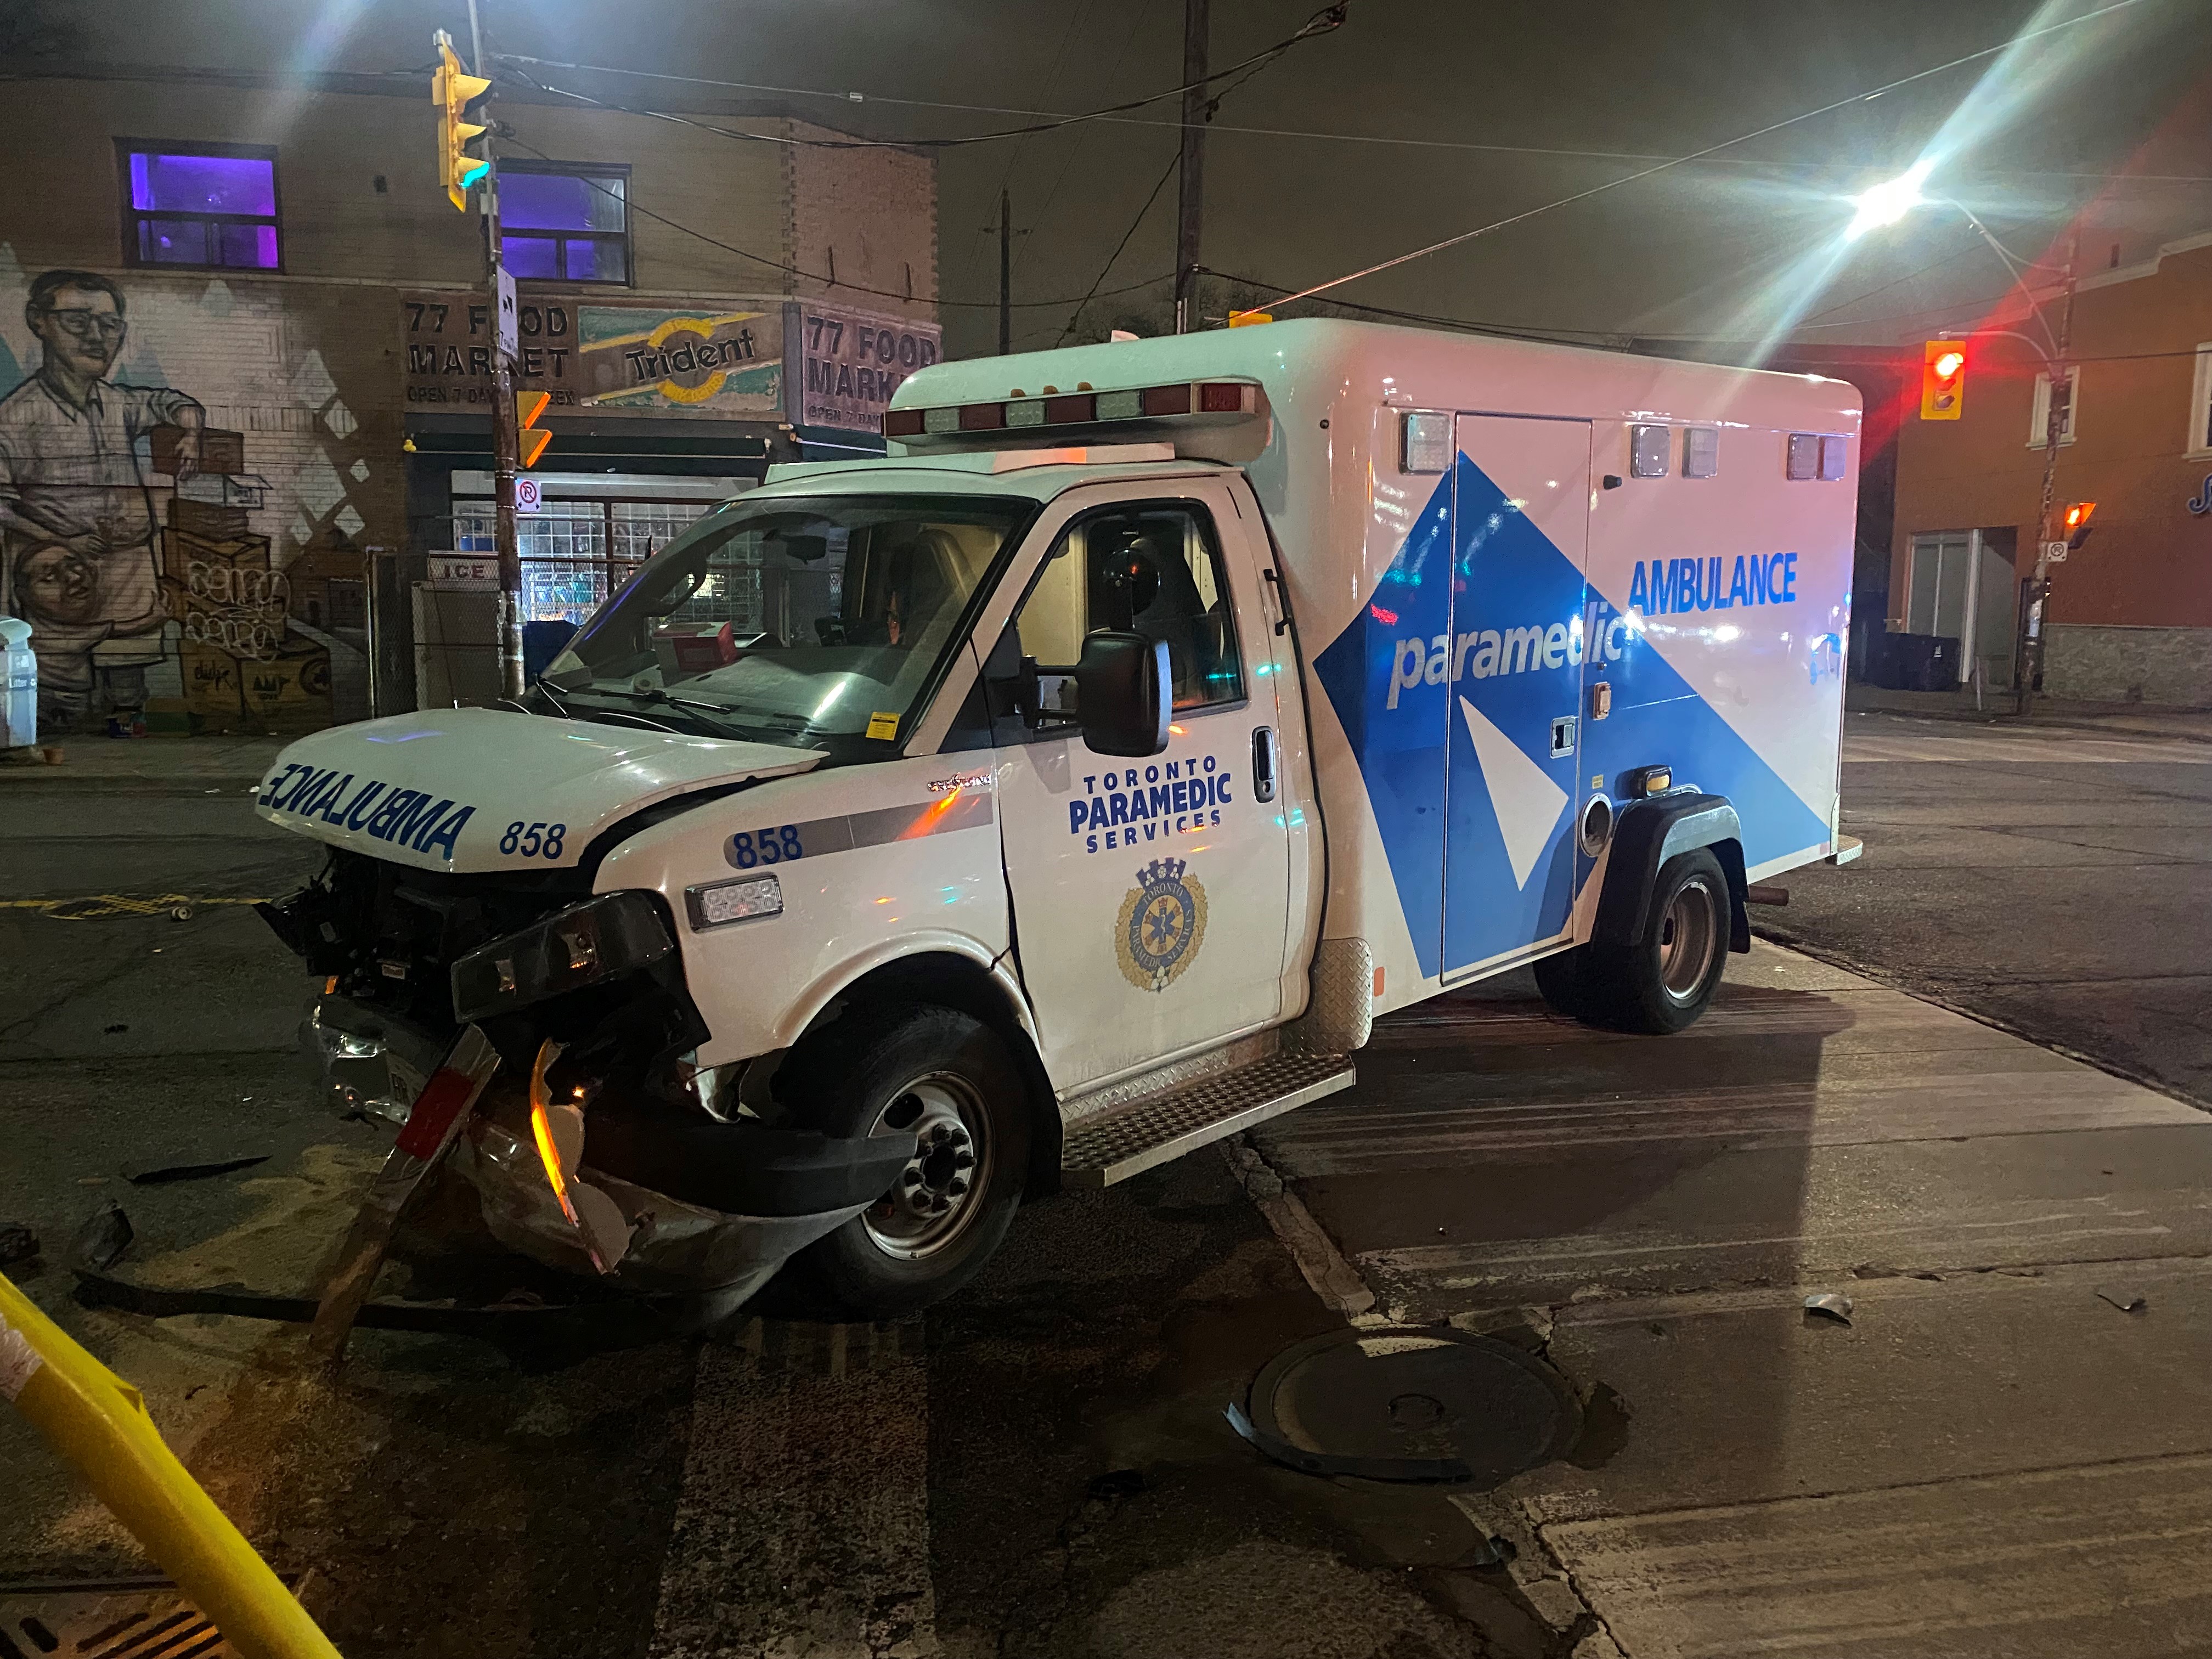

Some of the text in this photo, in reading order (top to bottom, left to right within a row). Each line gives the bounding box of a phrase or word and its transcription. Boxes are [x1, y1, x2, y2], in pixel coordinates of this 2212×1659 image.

[405, 303, 568, 337] 77 FOD
[409, 344, 569, 377] MARET
[625, 329, 754, 381] Trident
[807, 317, 936, 369] 77 FOOD
[409, 386, 447, 403] OPEN
[452, 387, 462, 404] 7
[808, 405, 842, 422] OPEN
[444, 565, 484, 579] ICE
[1628, 552, 1798, 617] AMBULANCE
[1386, 601, 1627, 710] paramedic
[1084, 755, 1216, 794] TORONTO
[1069, 772, 1233, 834] PARAMEDIC
[499, 821, 566, 860] 858
[733, 824, 803, 869] 858
[1086, 809, 1221, 854] SERVICES
[1142, 882, 1184, 906] TORONTO
